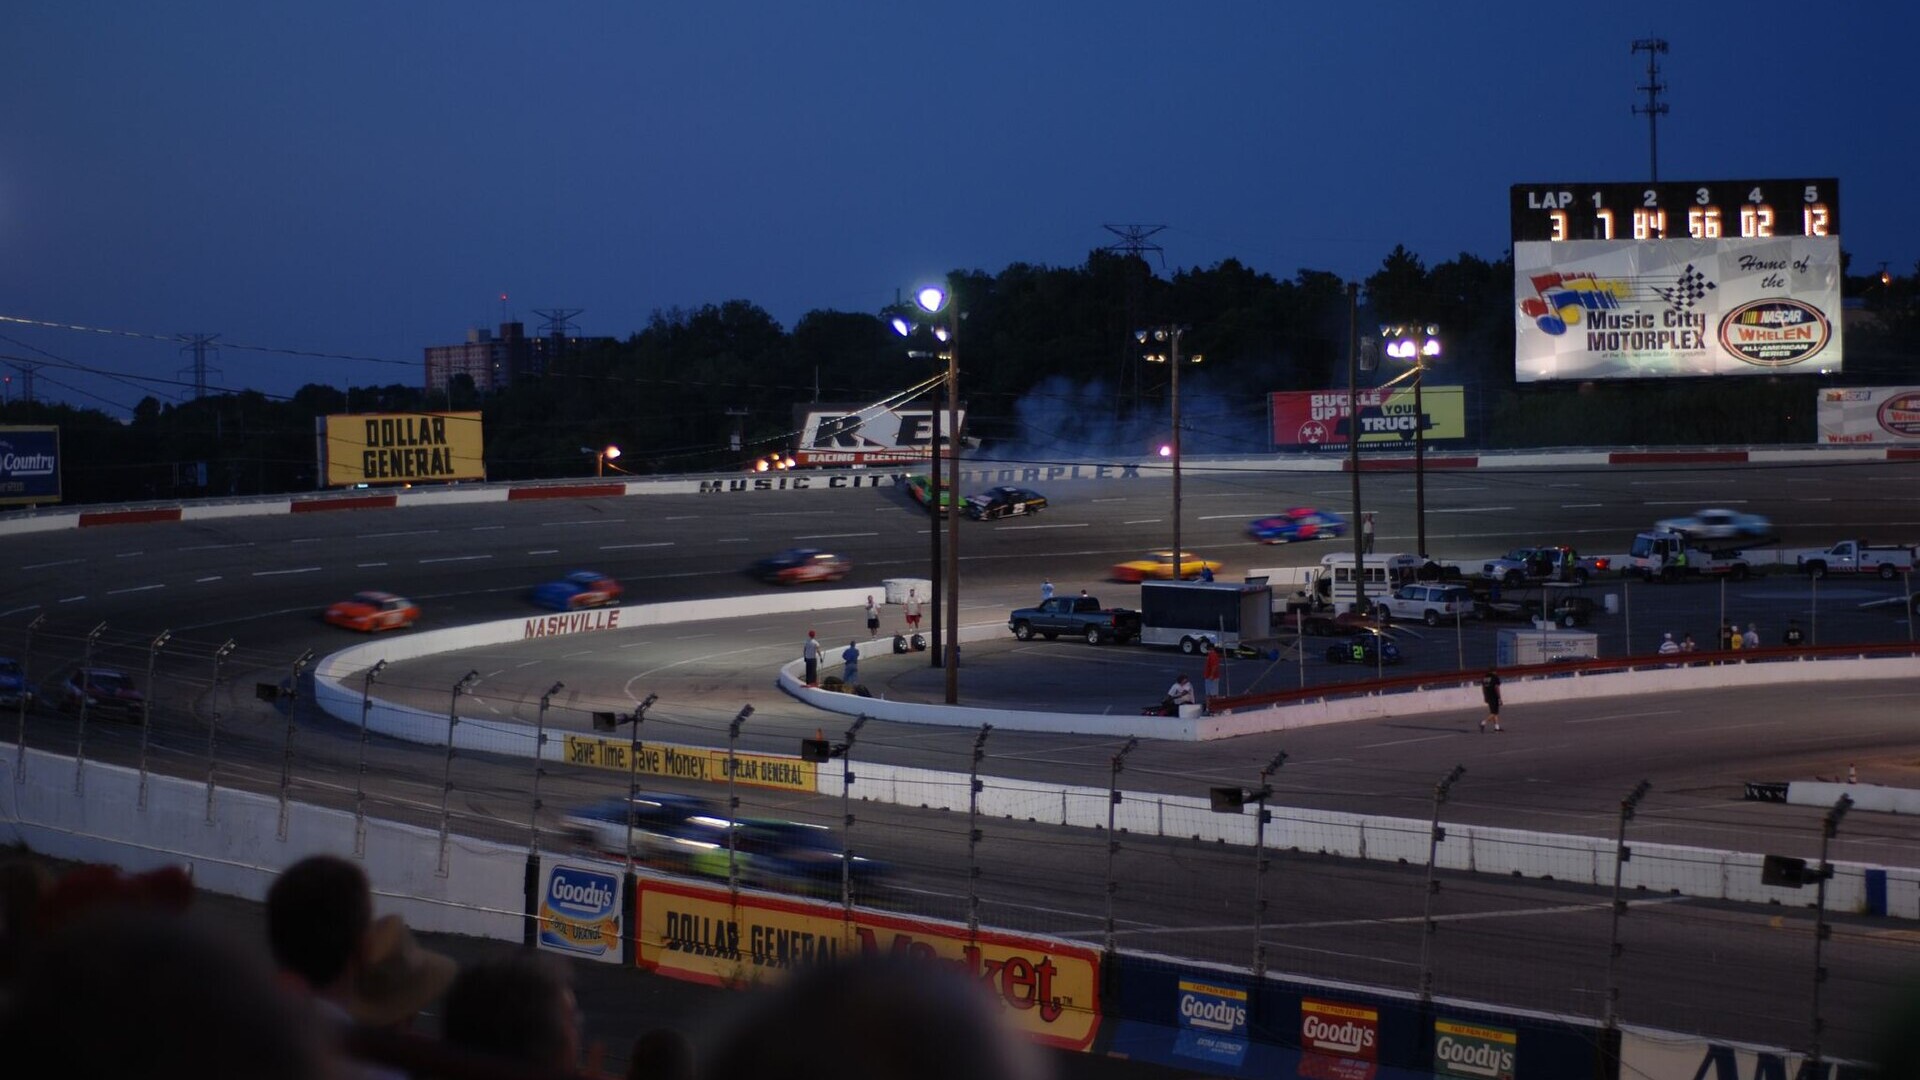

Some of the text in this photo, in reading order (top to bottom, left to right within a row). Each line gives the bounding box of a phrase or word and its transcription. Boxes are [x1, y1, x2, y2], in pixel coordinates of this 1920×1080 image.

[1528, 186, 1818, 209] LAP 1 2 3 4 5
[1550, 213, 1567, 241] 3
[1597, 213, 1613, 240] 7
[1740, 209, 1774, 238] 02
[1804, 207, 1829, 237] 12
[1738, 254, 1810, 273] Home of
[1761, 273, 1784, 288] the
[1587, 309, 1706, 333] Music City
[1761, 310, 1803, 323] NASCAR
[1587, 330, 1706, 351] MOTORPLEX
[1738, 325, 1811, 341] WHELEN
[1311, 407, 1336, 421] UP
[366, 416, 447, 448] DOLLAR
[3, 452, 55, 476] Country
[363, 447, 455, 478] GENERAL
[807, 453, 855, 463] RACING
[700, 478, 810, 493] MUSIC
[962, 465, 1140, 482] OTORPLEX
[525, 610, 620, 638] NASHVILLE
[570, 736, 595, 764] Save
[664, 748, 708, 779] Money.
[723, 758, 803, 785] DLLAR GENERAL
[552, 875, 612, 914] Goody's
[667, 911, 741, 961] DOLLAR
[1181, 994, 1246, 1031] Goody's
[1303, 1015, 1375, 1053] Goody's
[1437, 1036, 1513, 1076] Goody's
